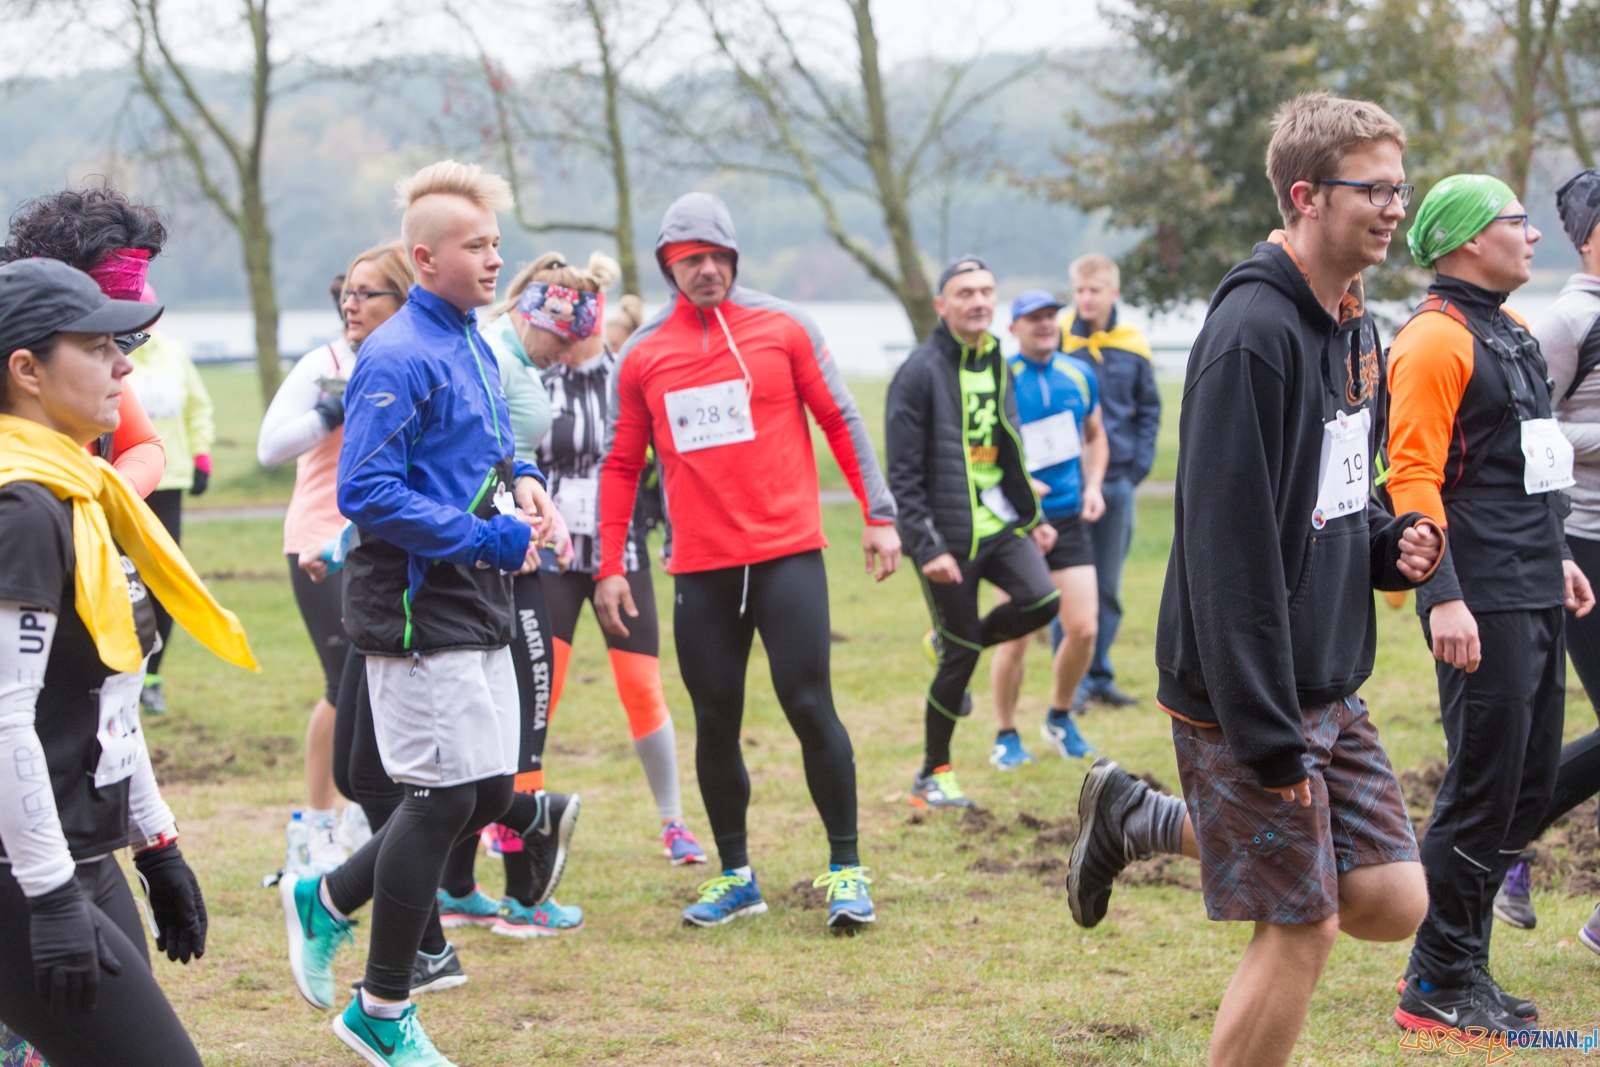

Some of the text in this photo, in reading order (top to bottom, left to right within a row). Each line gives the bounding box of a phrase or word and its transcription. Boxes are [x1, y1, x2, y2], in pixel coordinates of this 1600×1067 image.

[695, 405, 721, 426] 28
[1342, 453, 1364, 485] 19
[1545, 446, 1555, 468] 9
[19, 606, 49, 654] UP!
[518, 608, 550, 731] AGATA SZYSZKA
